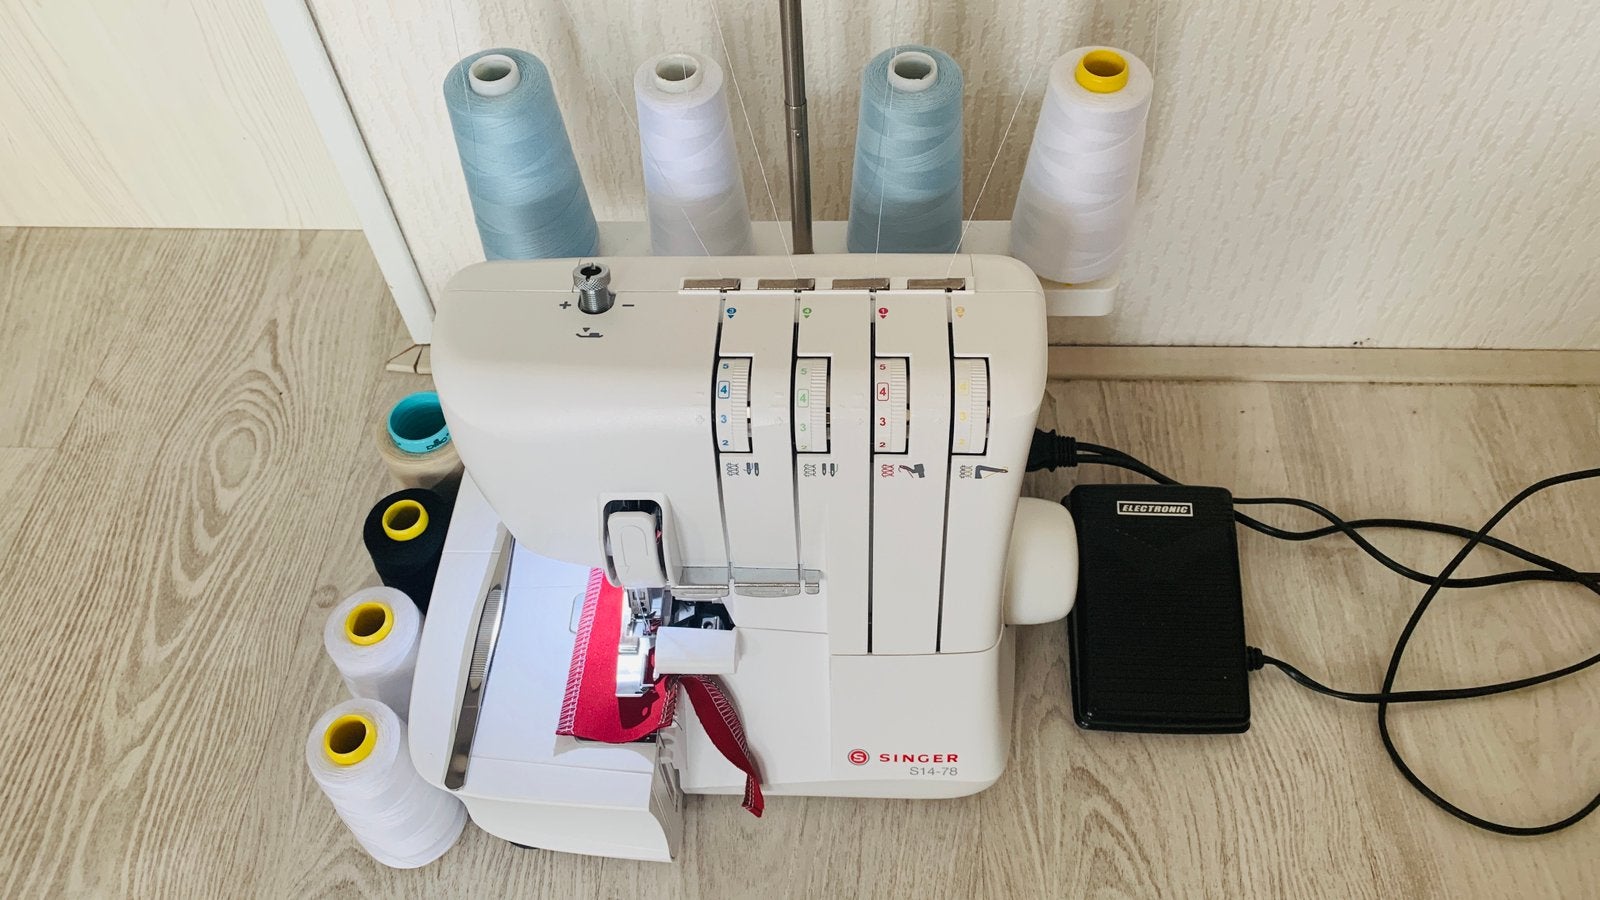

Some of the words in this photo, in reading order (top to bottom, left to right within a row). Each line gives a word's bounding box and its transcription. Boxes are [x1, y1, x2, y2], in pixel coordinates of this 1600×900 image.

[800, 367, 808, 375] 5
[720, 384, 728, 395] 4
[879, 386, 887, 397] 4
[799, 392, 807, 403] 4
[720, 414, 728, 424] 3
[879, 417, 887, 427] 3
[799, 423, 807, 432] 3
[1122, 504, 1188, 513] ELECTRONIC
[879, 753, 959, 763] SINGER
[909, 766, 958, 776] S14-78
